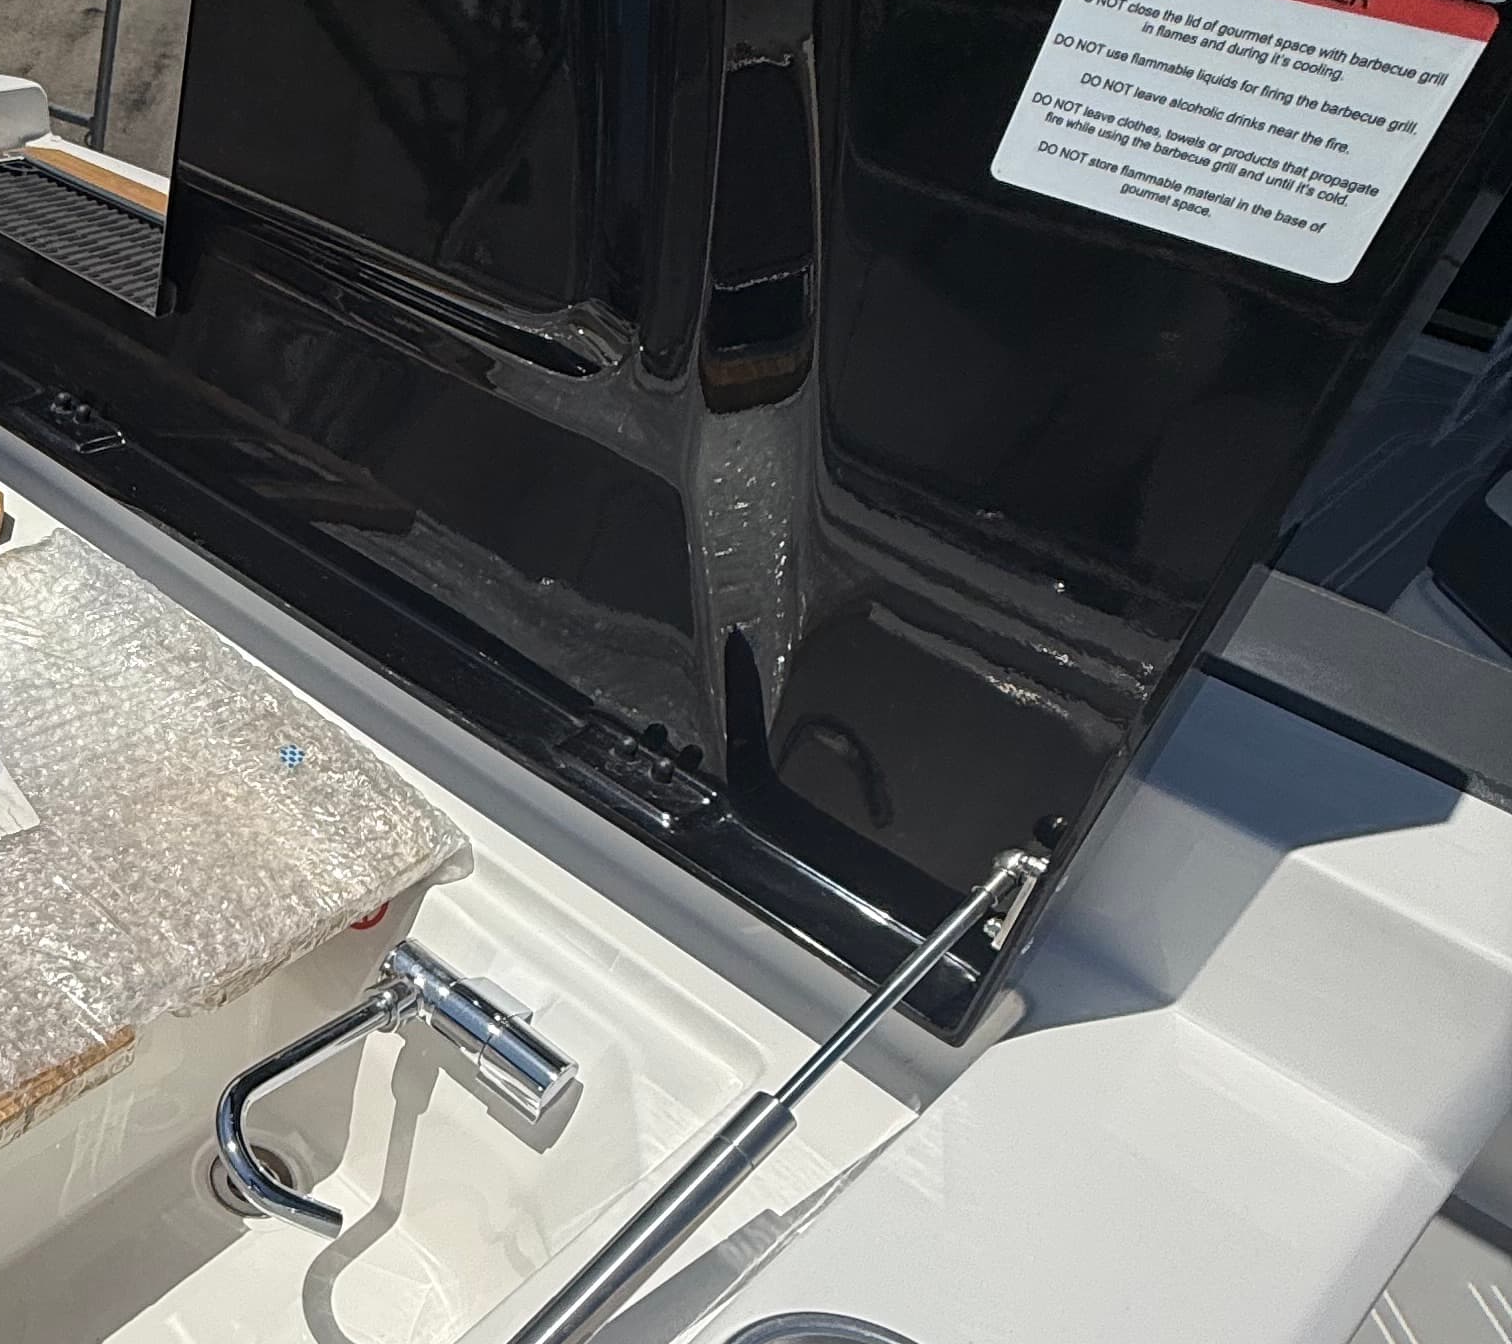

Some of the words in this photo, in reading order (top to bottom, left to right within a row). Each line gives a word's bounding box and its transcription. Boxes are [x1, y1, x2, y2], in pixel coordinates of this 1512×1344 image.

[1053, 32, 1074, 47] DO
[1074, 38, 1106, 55] NOT
[1105, 48, 1128, 61] use
[1130, 52, 1194, 78] flammable
[1195, 68, 1238, 89] liquids
[1239, 79, 1259, 94] for
[1259, 84, 1294, 105] firing
[1295, 94, 1318, 109] the
[1320, 100, 1386, 126] barbecue
[1386, 119, 1417, 135] grill.
[1126, 2, 1160, 18] close
[1161, 9, 1182, 24] the
[1183, 13, 1202, 28] lid
[1202, 19, 1219, 32] of
[1216, 24, 1273, 45] gourmet
[1274, 37, 1316, 55] space
[1318, 47, 1347, 63] with
[1348, 51, 1417, 78] barbecue
[1417, 71, 1449, 86] grill
[1141, 21, 1154, 34] in
[1155, 24, 1198, 44] flames
[1199, 37, 1226, 51] and
[1226, 42, 1269, 64] during
[1269, 51, 1291, 67] it's
[1292, 60, 1343, 82] cooling.
[1031, 92, 1052, 106] DO
[1052, 97, 1083, 114] NOT
[1082, 105, 1115, 123] leave
[1116, 116, 1161, 138] clothes,
[1165, 128, 1206, 148] towels
[1207, 142, 1222, 153] or
[1221, 146, 1280, 168] products
[1281, 160, 1309, 178] that
[1307, 170, 1379, 196] propagate
[1079, 72, 1102, 87] DO
[1101, 78, 1134, 95] NOT
[1132, 86, 1167, 105] leave
[1168, 97, 1225, 120] alcoholic
[1225, 111, 1266, 130] drinks
[1266, 123, 1300, 139] near
[1300, 131, 1323, 146] the
[1324, 137, 1349, 154] fire.
[1037, 140, 1058, 155] DO
[1058, 146, 1089, 163] NOT
[1087, 157, 1118, 173] store
[1119, 164, 1182, 192] flammable
[1183, 185, 1236, 207] material
[1235, 198, 1249, 211] in
[1250, 203, 1272, 218] the
[1273, 209, 1307, 228] base
[1309, 222, 1327, 233] of
[1044, 111, 1064, 125] fire
[1065, 118, 1096, 134] while
[1097, 127, 1130, 146] using
[1131, 136, 1151, 150] the
[1152, 141, 1211, 166] barbecue
[1210, 160, 1238, 174] grill
[1237, 167, 1265, 181] and
[1265, 175, 1295, 190] until
[1294, 181, 1315, 196] it's
[1316, 190, 1348, 206] cold.
[1119, 183, 1171, 205] gourmet
[1171, 198, 1210, 217] space.
